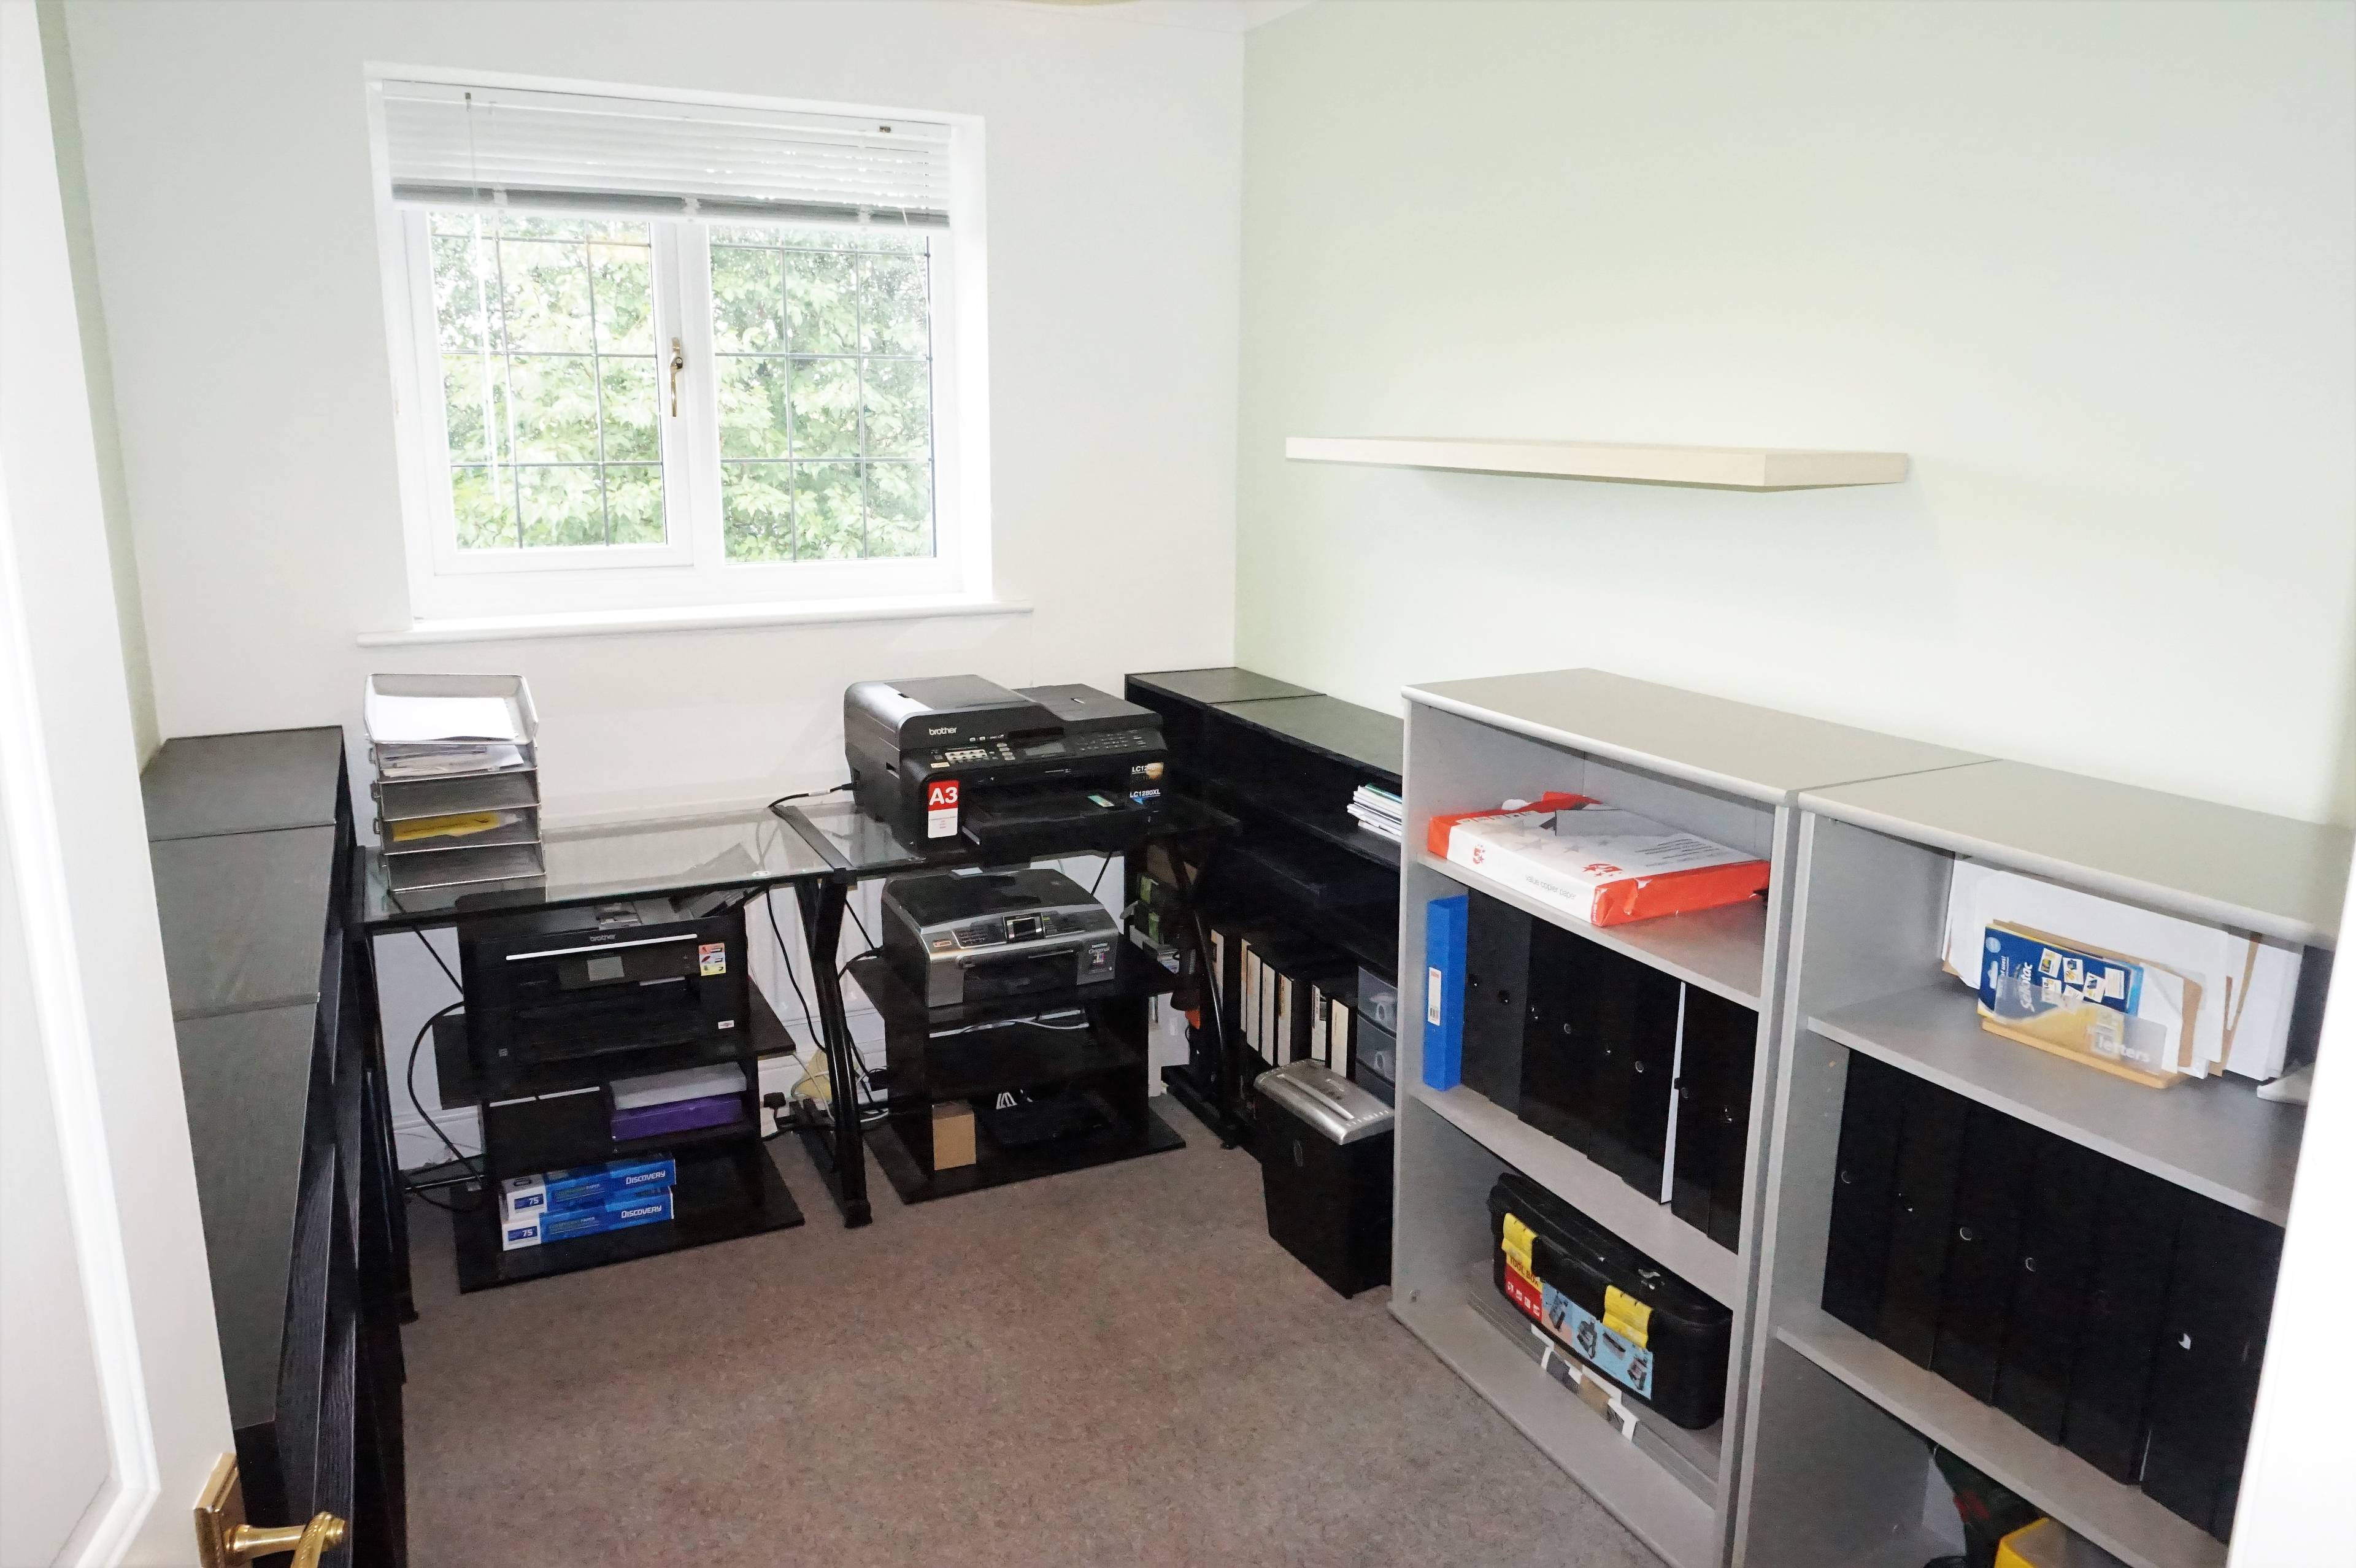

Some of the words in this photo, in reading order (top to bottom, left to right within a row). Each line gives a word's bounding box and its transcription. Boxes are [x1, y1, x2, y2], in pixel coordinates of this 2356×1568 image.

[928, 727, 957, 736] brother
[929, 786, 958, 805] A3
[1130, 789, 1161, 797] LC1280XL
[1541, 882, 1558, 893] copier
[626, 1170, 666, 1185] DISCOVERY
[529, 1196, 539, 1205] 75
[621, 1205, 662, 1219] DISCOVERY
[522, 1228, 533, 1237] 75
[1511, 1256, 1525, 1275] TOOL
[1526, 1270, 1539, 1287] BOX
